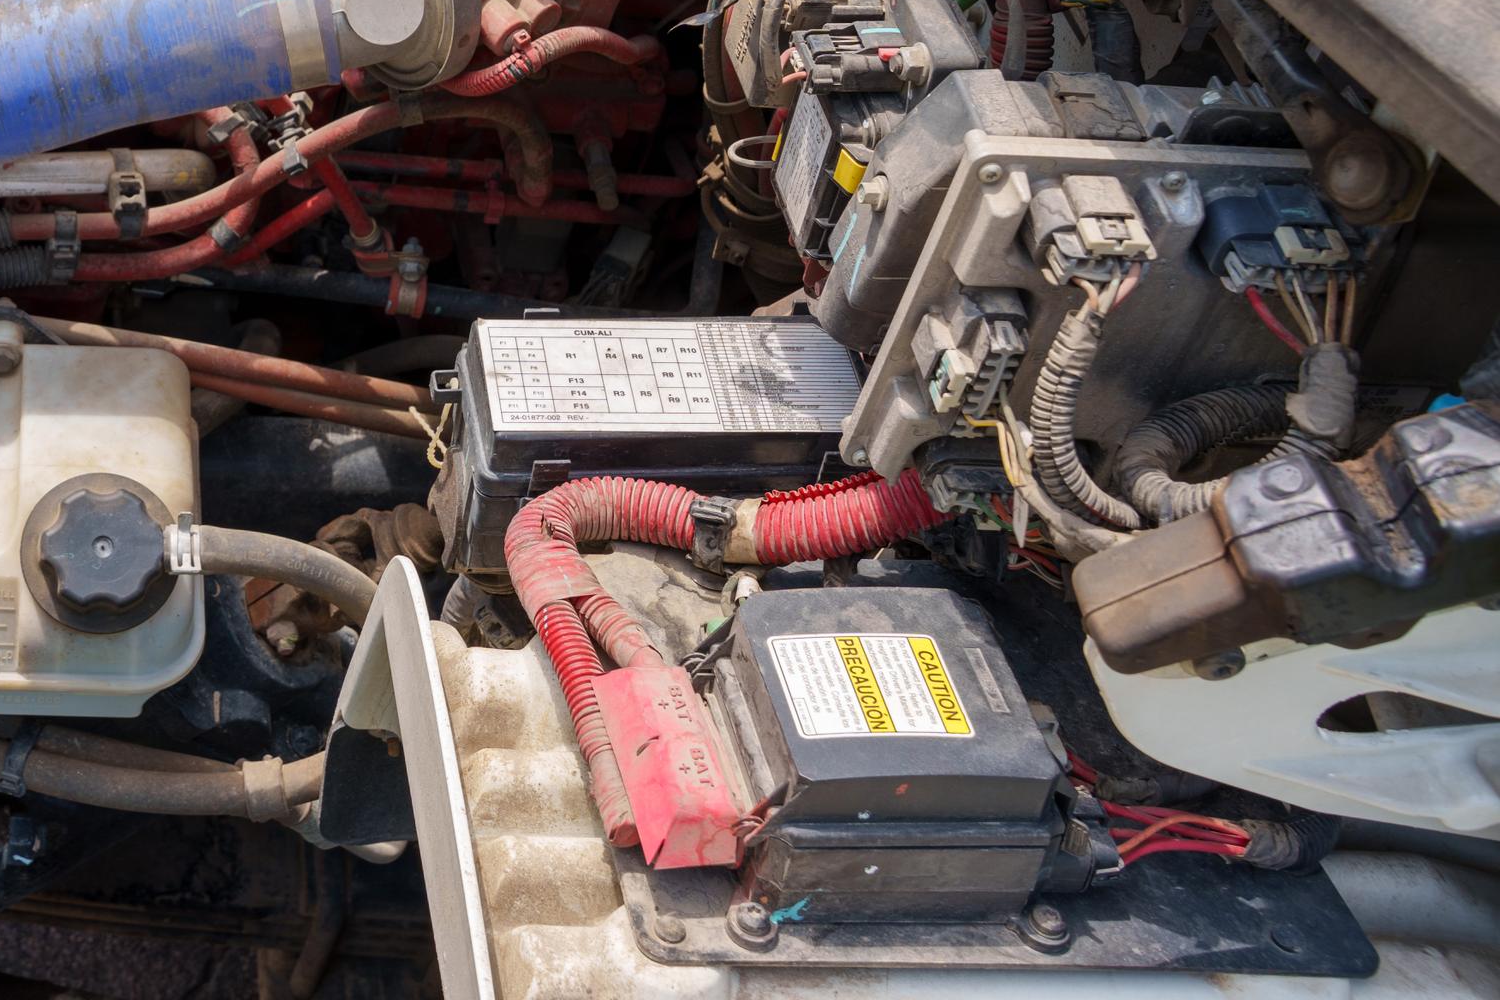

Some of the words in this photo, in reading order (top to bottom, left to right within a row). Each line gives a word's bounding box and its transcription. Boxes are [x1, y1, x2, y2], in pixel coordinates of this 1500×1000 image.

[837, 638, 892, 729] PRECAUCIÓN
[916, 650, 961, 721] CAUTION
[669, 686, 692, 722] BAT
[897, 695, 913, 717] Manual
[691, 748, 714, 787] BAT
